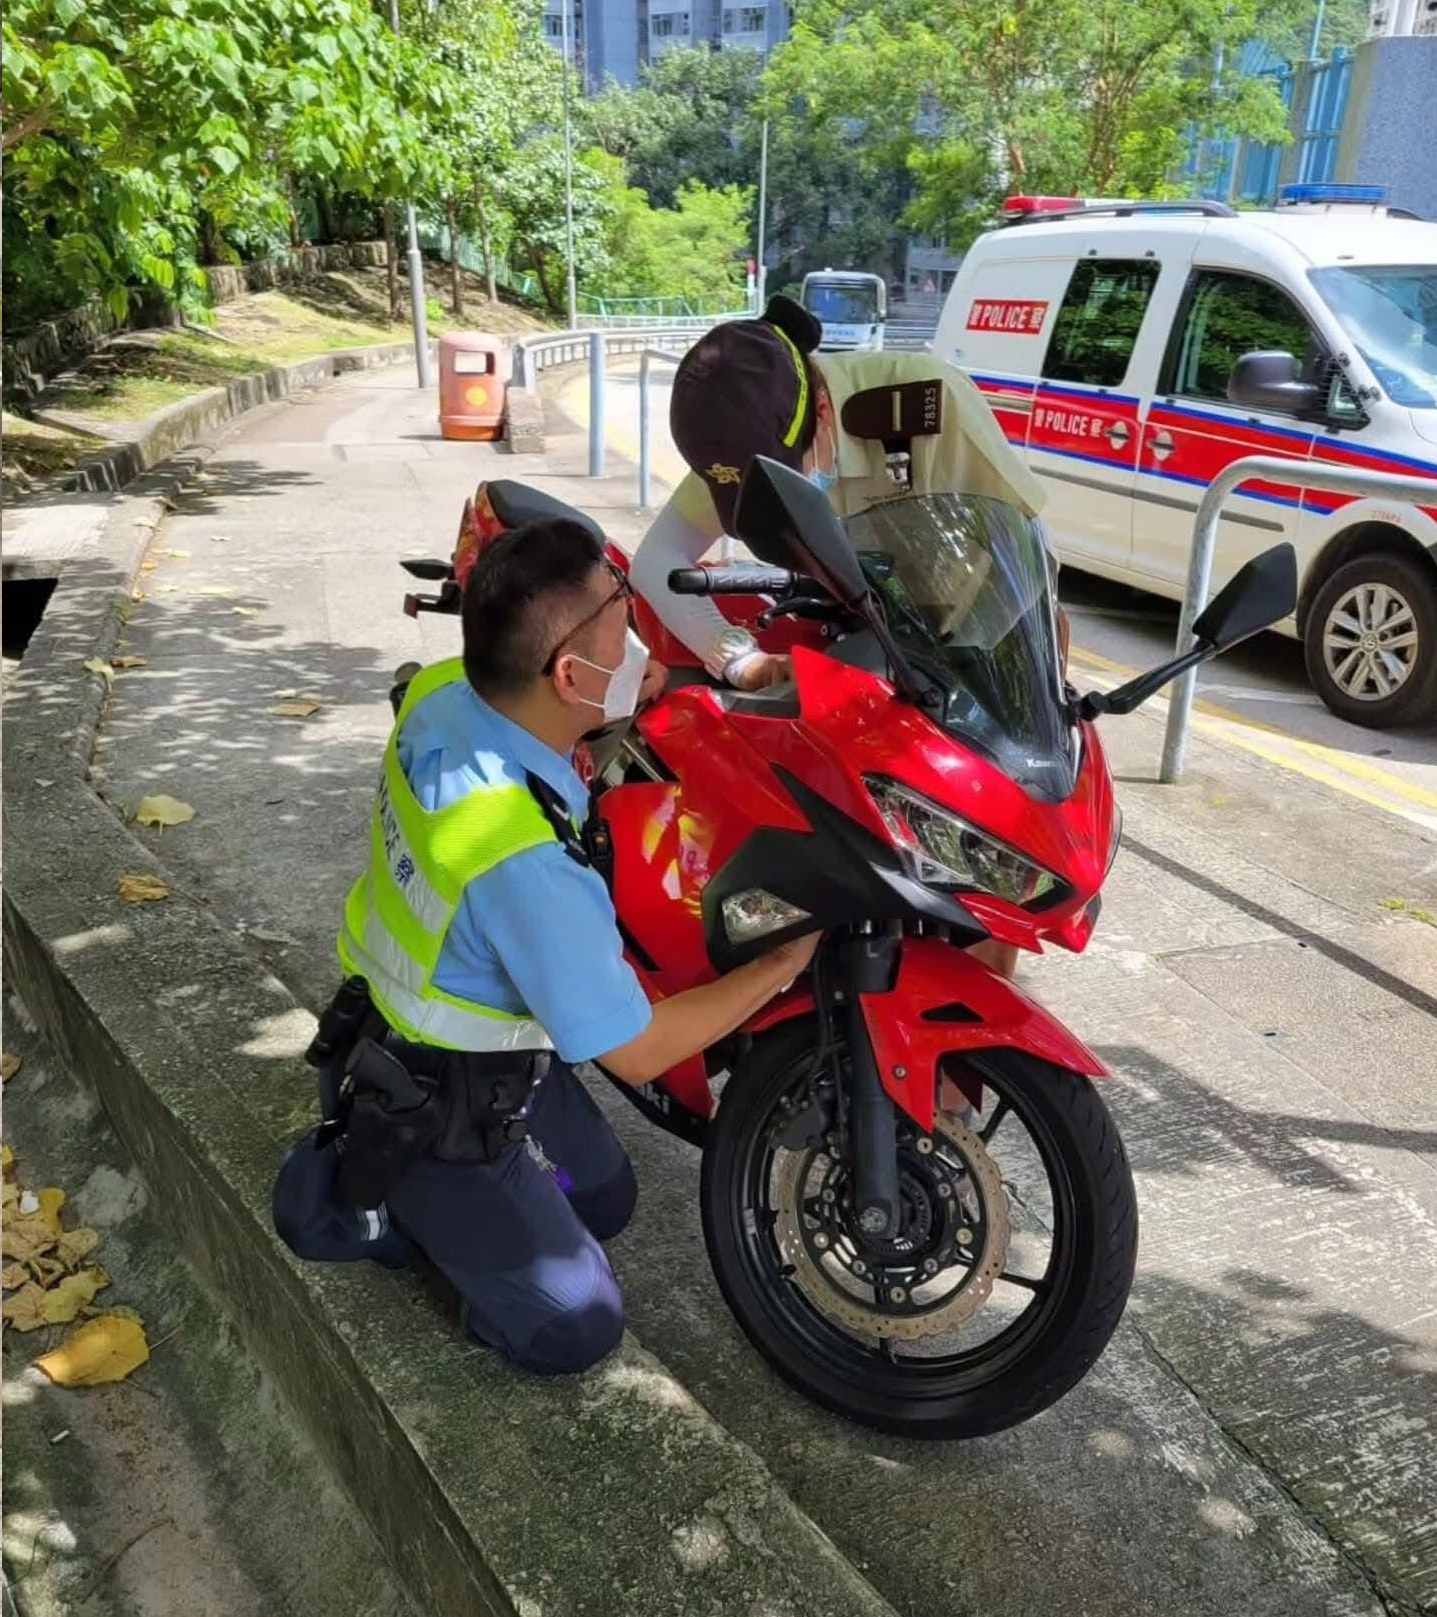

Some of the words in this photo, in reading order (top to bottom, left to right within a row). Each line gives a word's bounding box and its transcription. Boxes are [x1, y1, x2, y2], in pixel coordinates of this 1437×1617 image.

[980, 305, 1031, 329] POLICE
[924, 387, 937, 428] 78325
[1045, 410, 1089, 437] POLICE
